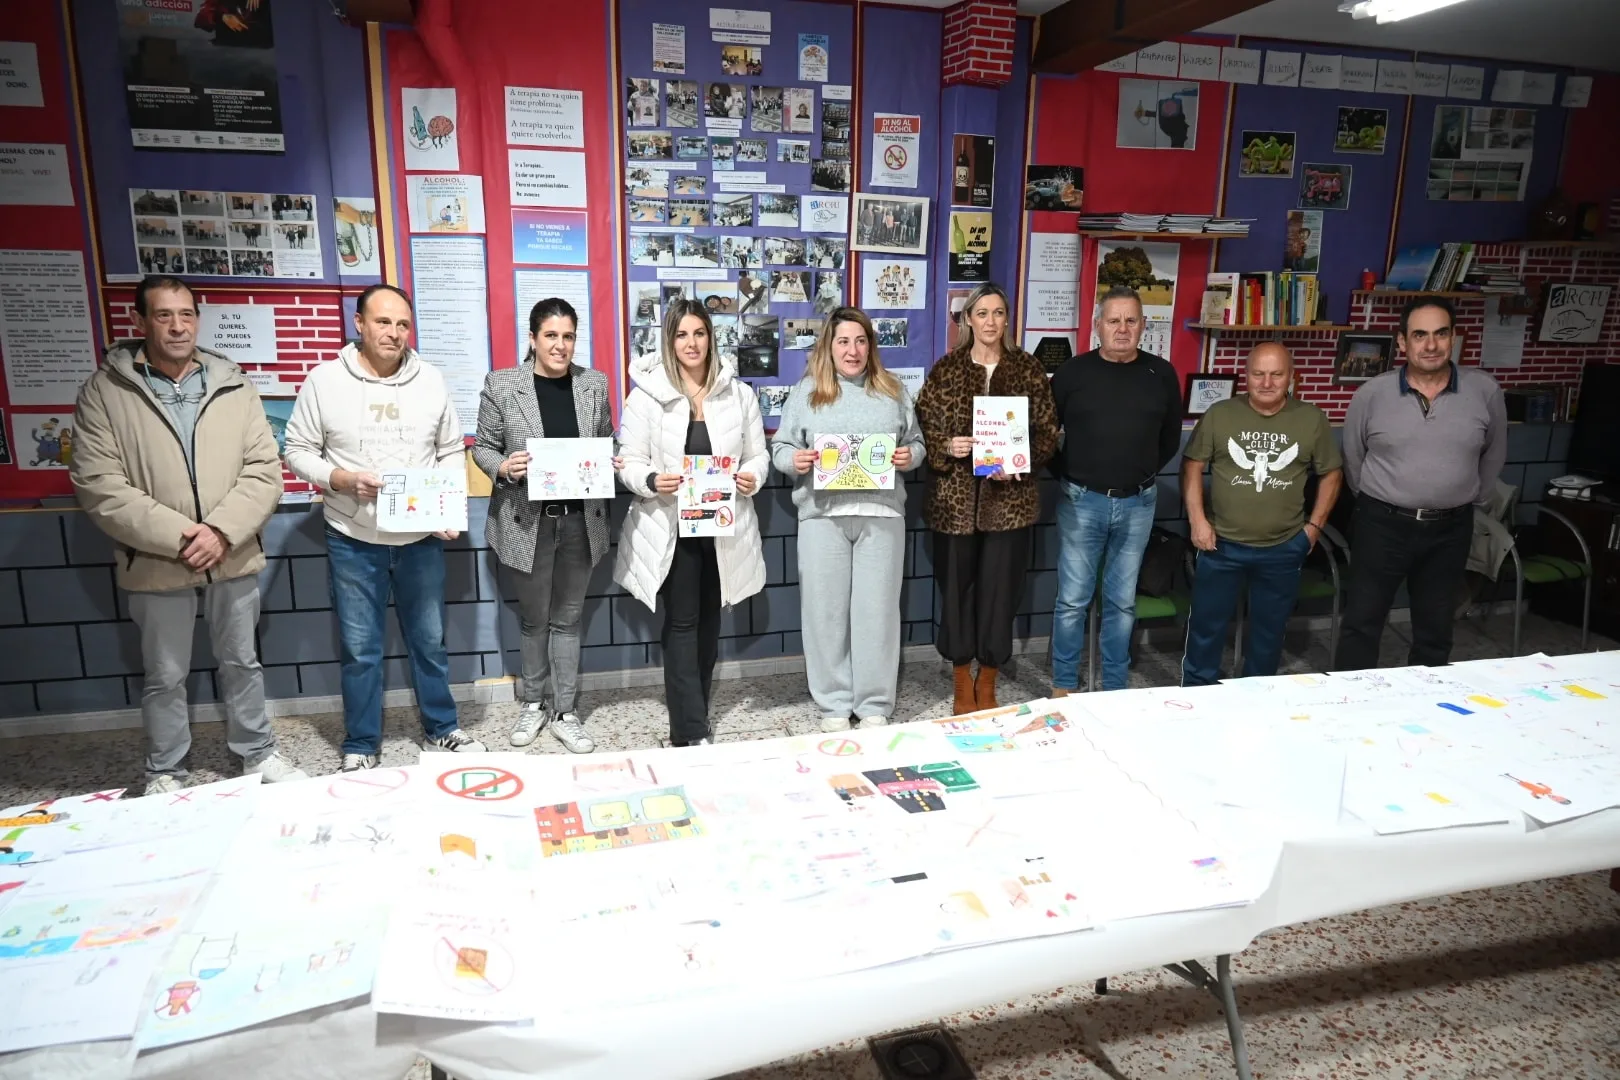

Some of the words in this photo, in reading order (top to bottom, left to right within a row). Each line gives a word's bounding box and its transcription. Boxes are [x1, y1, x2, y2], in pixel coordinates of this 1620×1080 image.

[517, 90, 540, 99] terapia
[560, 93, 579, 101] quien
[510, 98, 526, 106] tiene
[520, 121, 543, 130] terapia
[554, 124, 574, 132] quien
[511, 130, 533, 139] quiere
[967, 240, 988, 248] ALCOHOL
[369, 402, 400, 423] 76
[1250, 440, 1277, 450] CLUB
